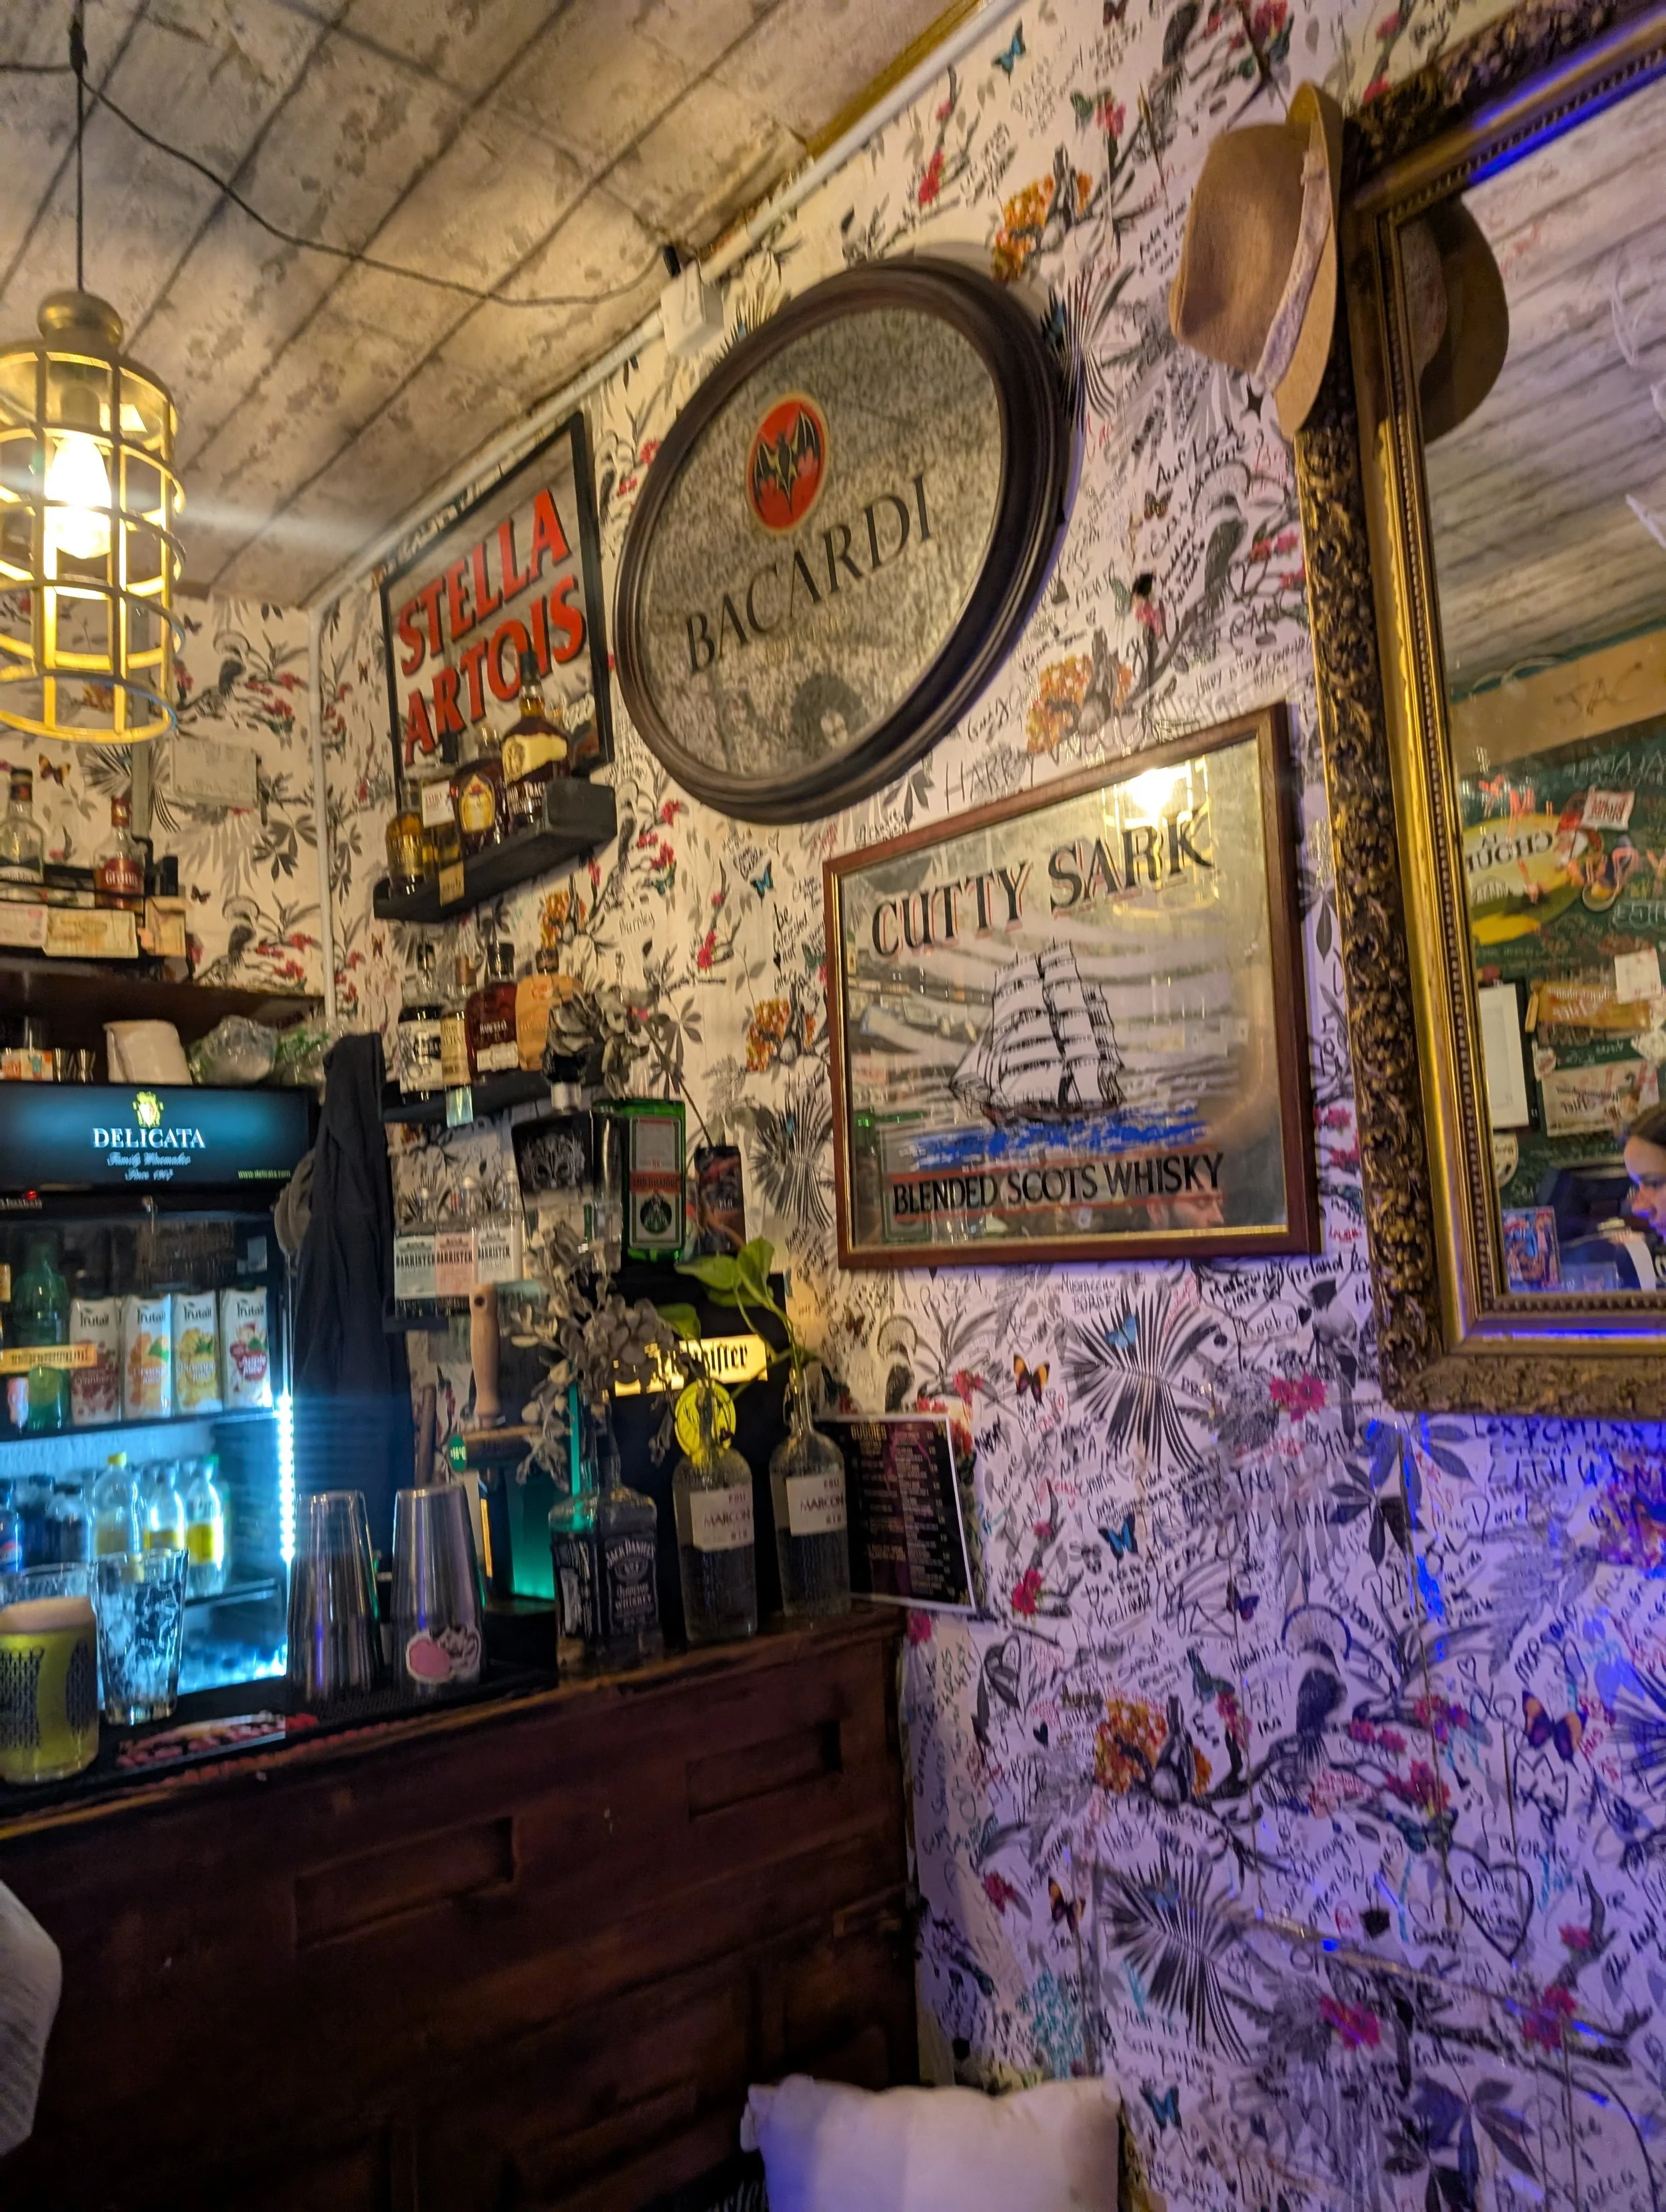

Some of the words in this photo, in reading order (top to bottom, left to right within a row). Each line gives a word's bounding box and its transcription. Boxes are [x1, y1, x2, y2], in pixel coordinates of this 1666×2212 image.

[398, 488, 572, 677] STELLA
[684, 472, 934, 674] BACARDI
[404, 574, 587, 766] ARTOIS
[872, 861, 1033, 961] CUTTY
[1048, 806, 1214, 913] SARK
[93, 1128, 206, 1149] DELICATA
[893, 1170, 998, 1216] BLENDED
[1009, 1165, 1098, 1202] SCOTS
[1105, 1153, 1224, 1194] WHISKY
